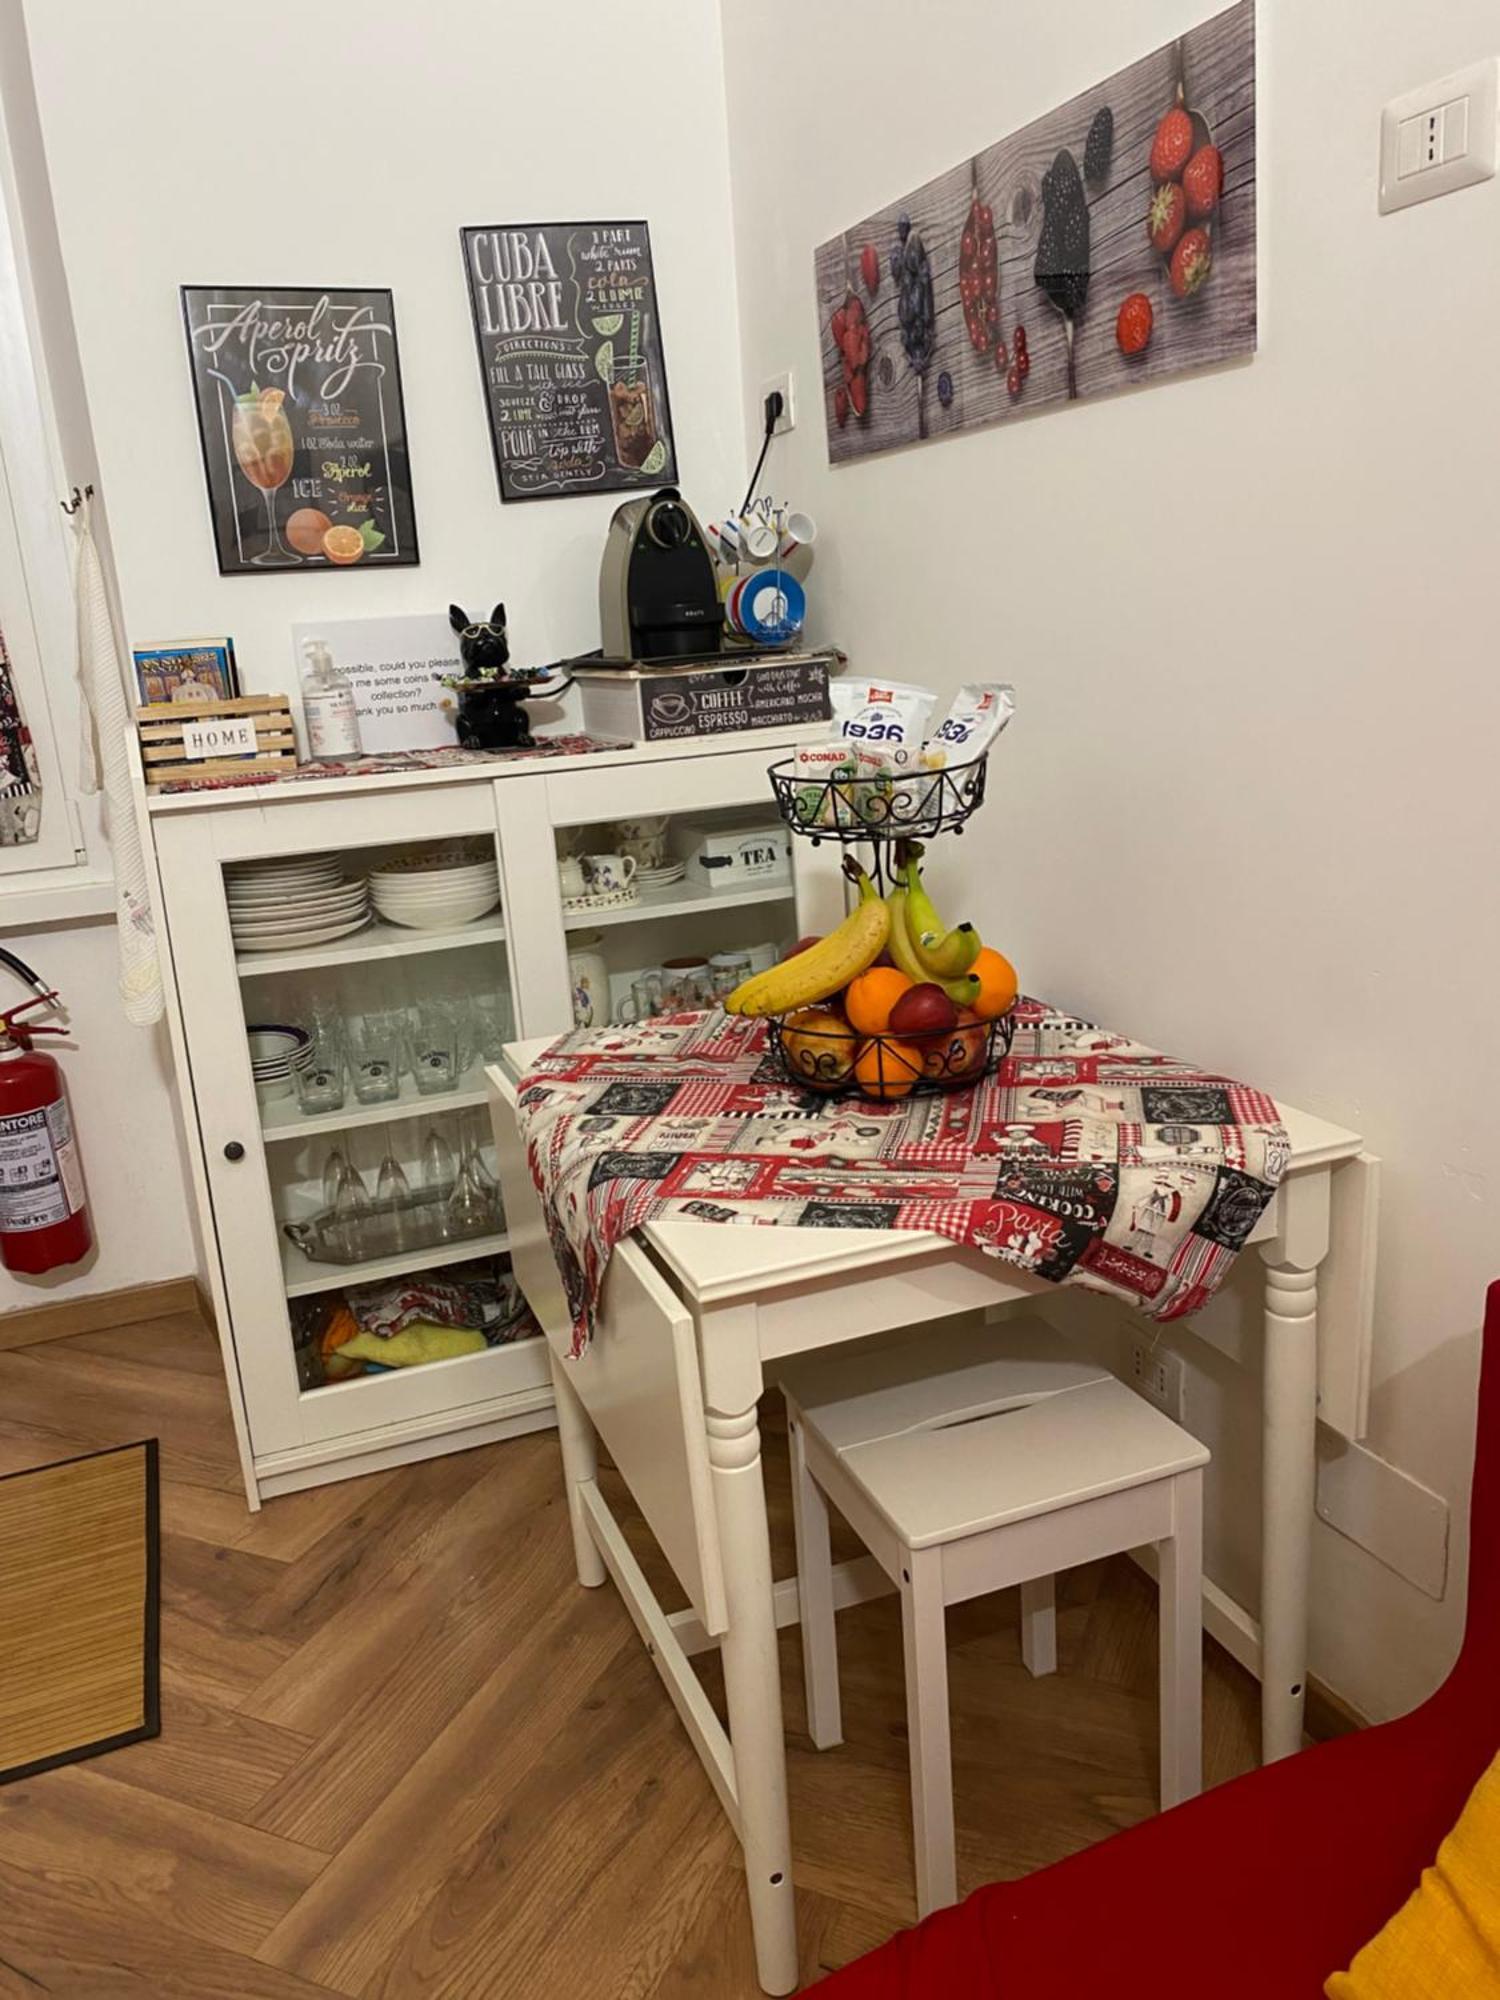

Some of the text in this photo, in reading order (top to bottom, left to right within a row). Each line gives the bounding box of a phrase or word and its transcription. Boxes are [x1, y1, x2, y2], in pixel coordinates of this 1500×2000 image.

[602, 229, 631, 243] PART
[472, 231, 558, 283] CUBA
[595, 259, 637, 272] 2 PARTS
[585, 290, 596, 303] 2
[479, 281, 568, 334] LIBRE
[192, 294, 329, 374] Aperol
[489, 362, 586, 384] FILL A TALL GLASS
[500, 409, 511, 422] 2
[501, 429, 538, 459] POUR
[291, 478, 323, 499] ICE
[379, 662, 406, 671] could
[408, 661, 426, 671] you
[428, 658, 460, 671] please
[356, 679, 371, 687] me
[374, 677, 401, 687] some
[403, 675, 429, 684] coins
[371, 687, 422, 701] collection?
[700, 690, 745, 709] COFFEE
[376, 706, 394, 718] you
[396, 704, 409, 713] so
[410, 701, 438, 712] much
[697, 710, 748, 729] ESPRESSO
[191, 728, 249, 748] HOME
[649, 723, 697, 739] CAPPUCCINO
[842, 720, 905, 743] 1936
[810, 752, 846, 762] CONAD
[740, 846, 777, 865] TEA
[0, 1111, 44, 1131] NTORE
[987, 1201, 1072, 1248] Pasta
